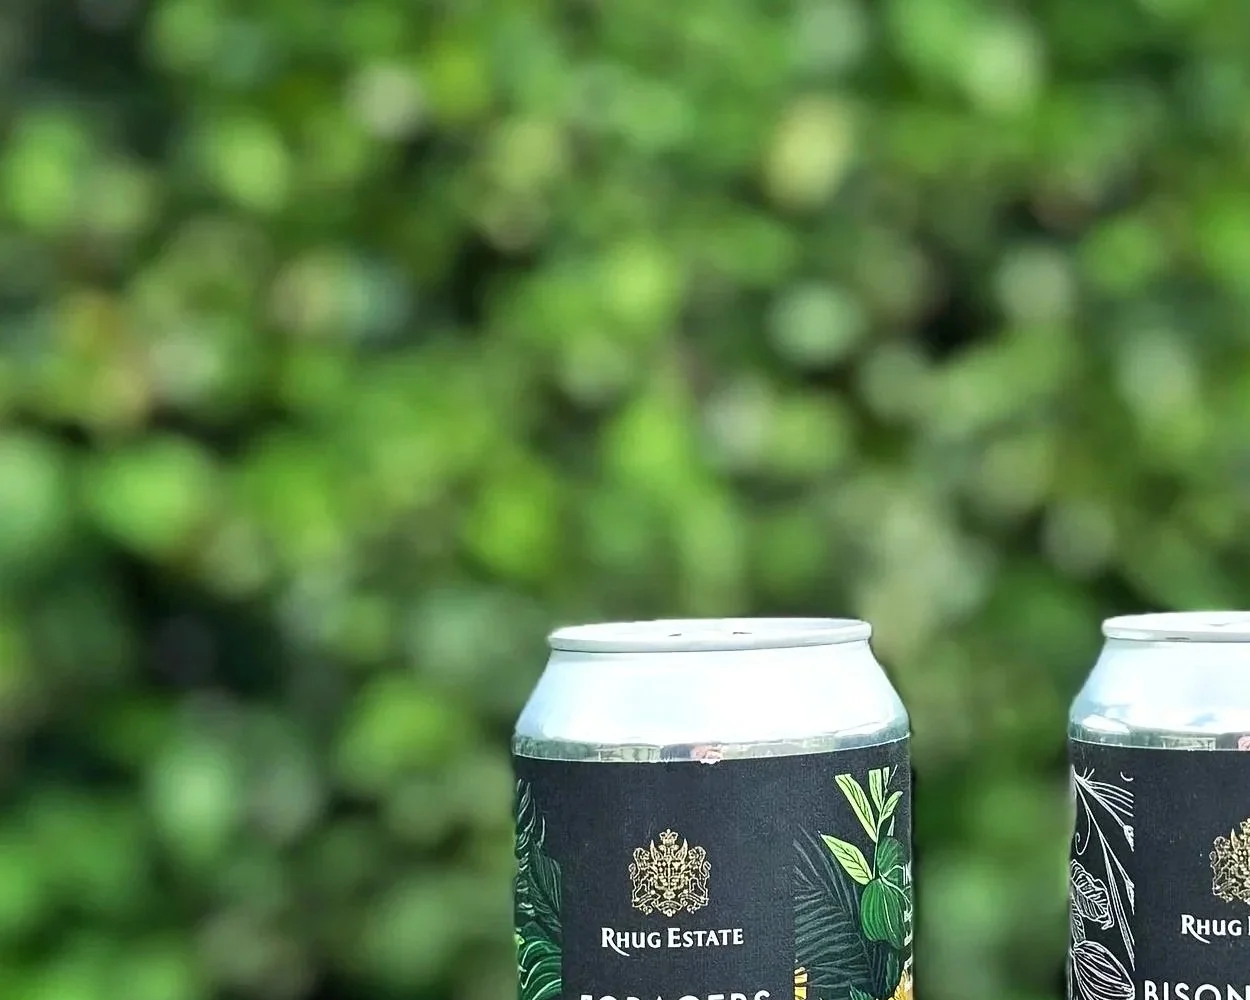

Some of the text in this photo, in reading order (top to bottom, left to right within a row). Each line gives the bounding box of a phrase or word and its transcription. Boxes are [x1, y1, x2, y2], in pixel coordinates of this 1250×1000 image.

[601, 927, 745, 956] RHUG ESTATE
[1180, 914, 1242, 943] RHUG
